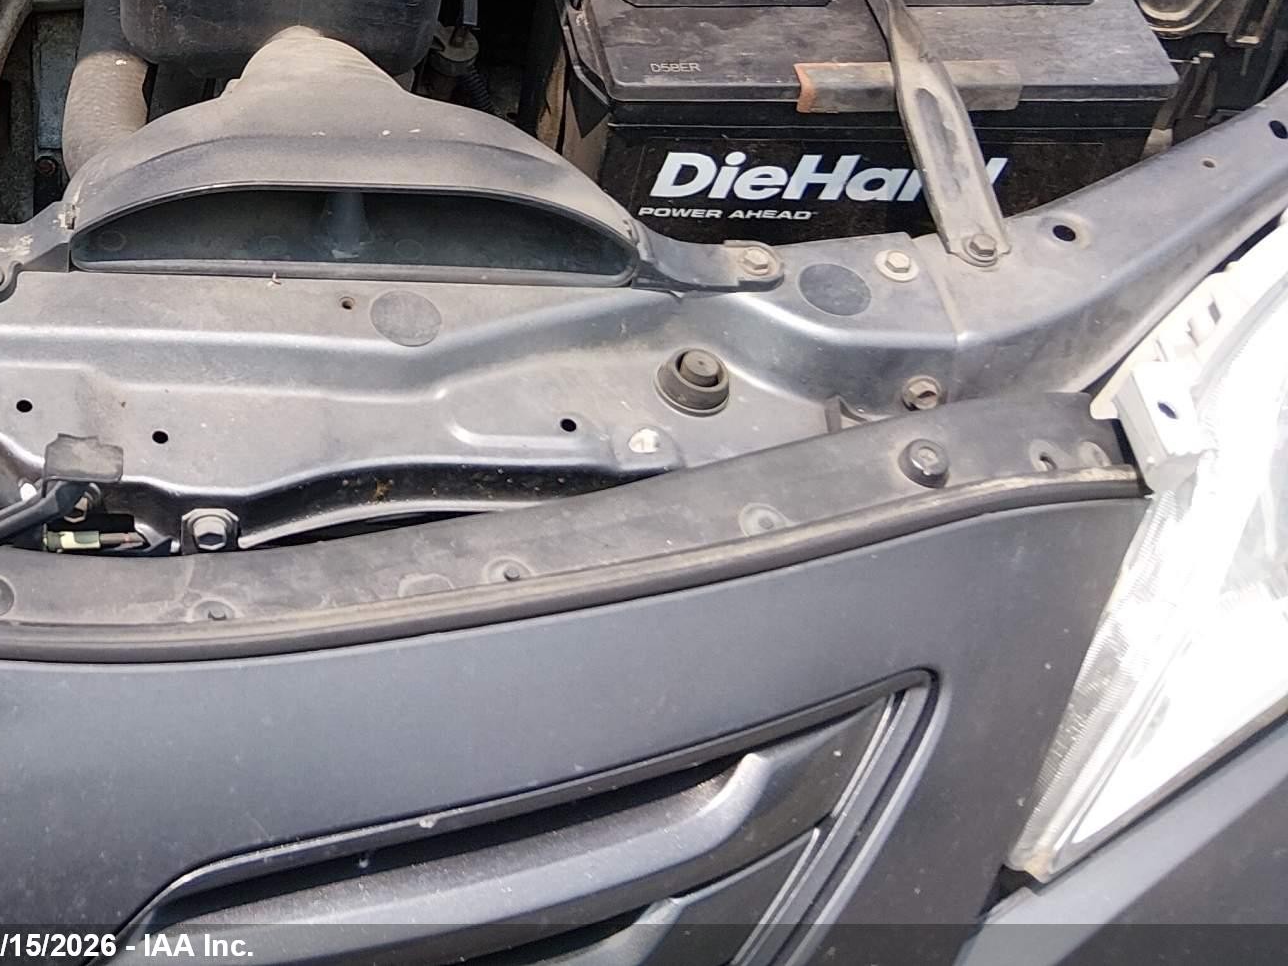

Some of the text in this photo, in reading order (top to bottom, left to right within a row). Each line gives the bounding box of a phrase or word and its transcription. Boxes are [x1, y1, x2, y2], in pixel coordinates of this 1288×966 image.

[649, 151, 1008, 202] DieHar
[638, 206, 813, 221] POWER AHEAD
